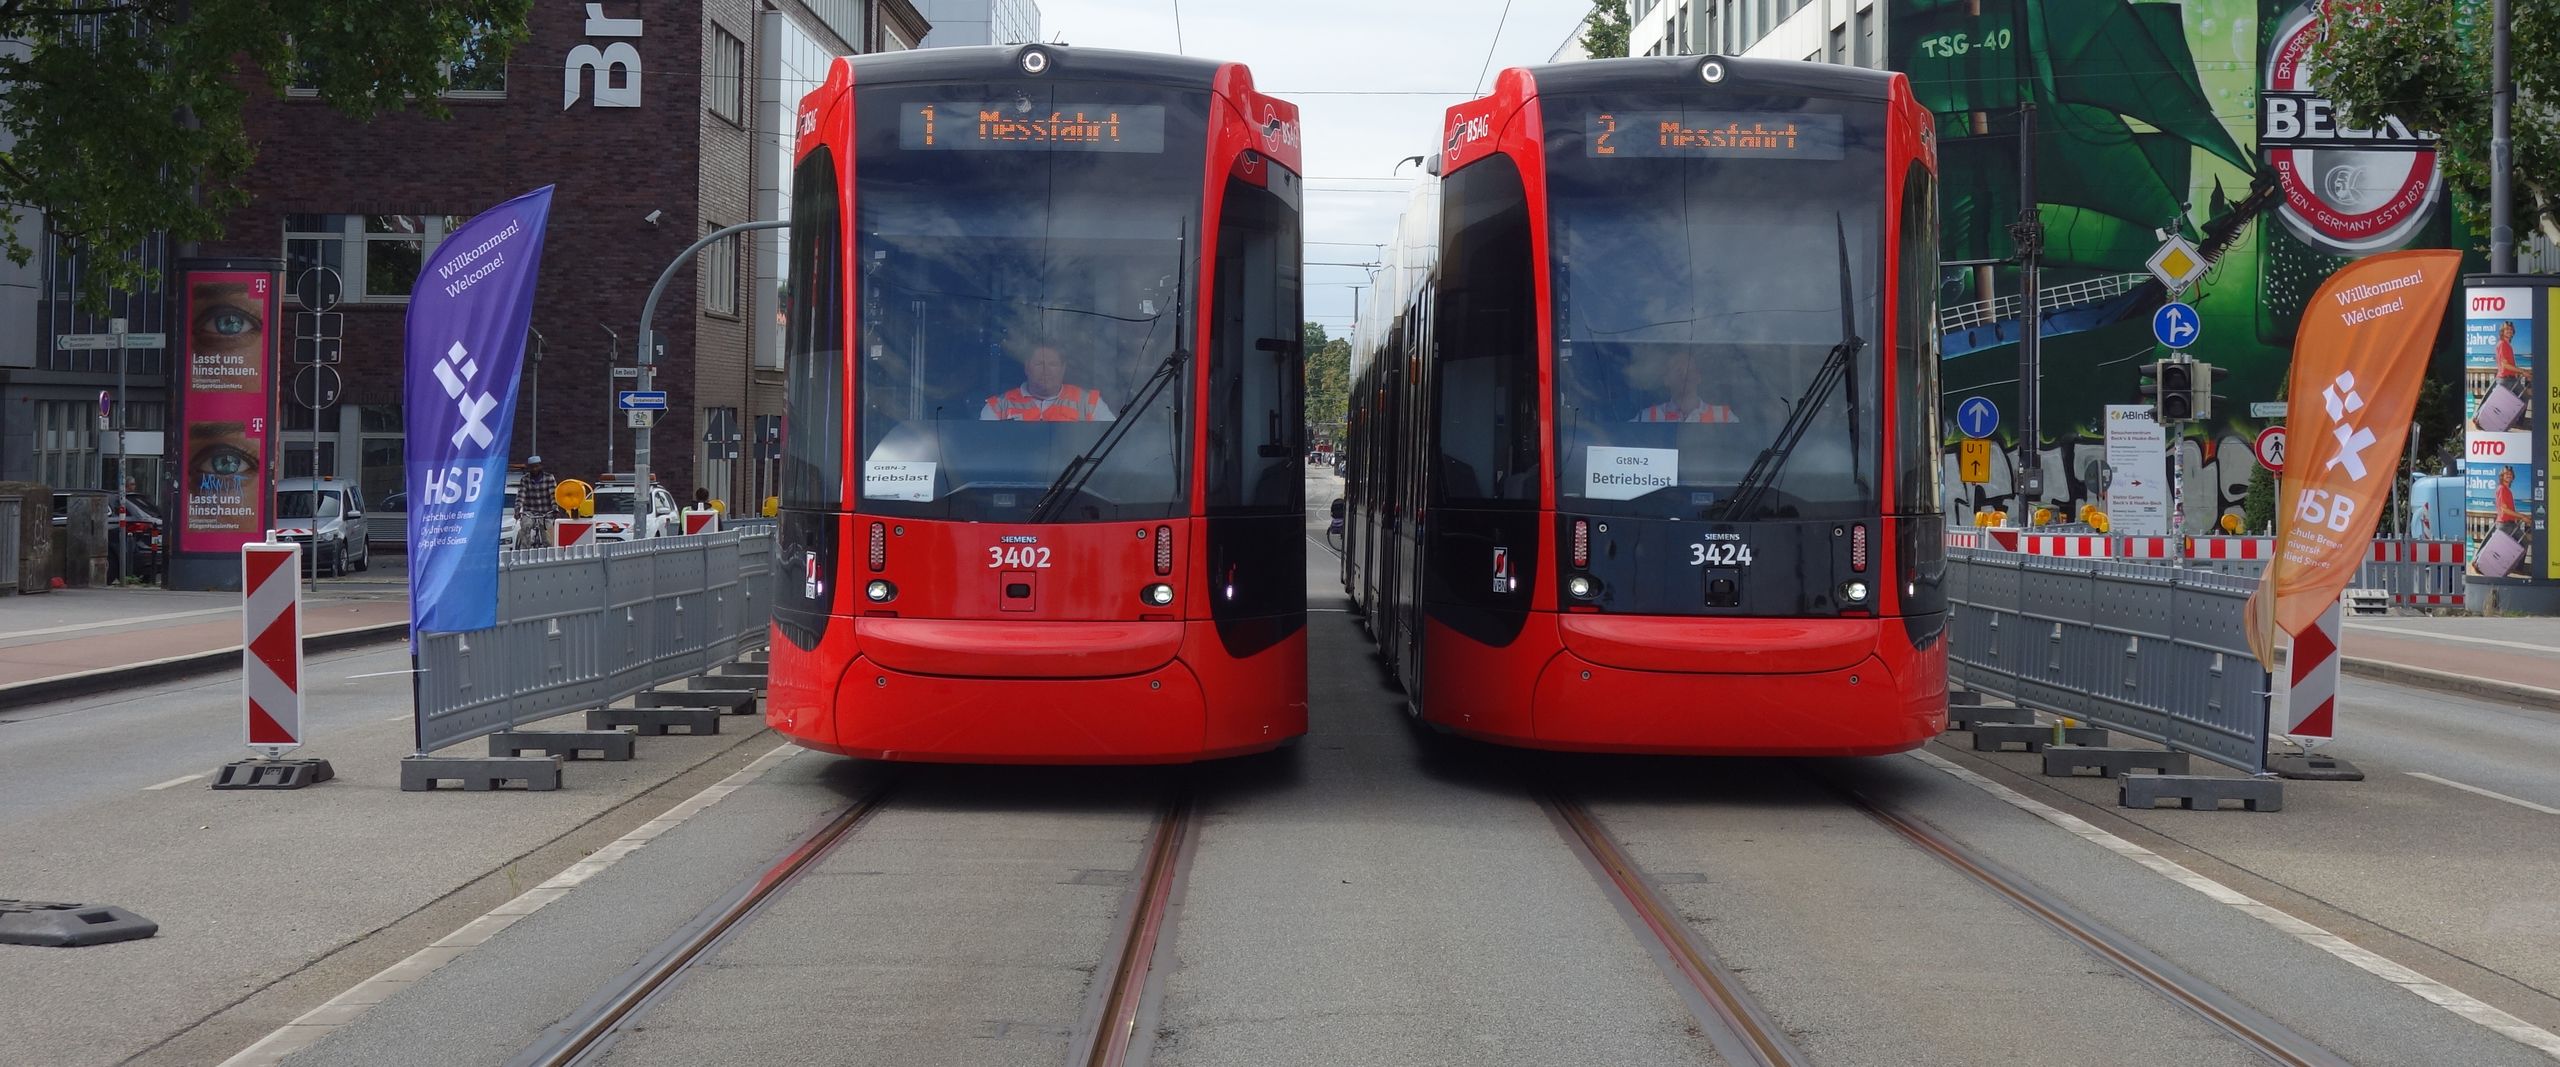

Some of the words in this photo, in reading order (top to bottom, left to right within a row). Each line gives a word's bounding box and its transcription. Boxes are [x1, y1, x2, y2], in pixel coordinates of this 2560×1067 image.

[1922, 28, 2011, 58] TSG-40
[564, 3, 643, 111] Br
[920, 104, 934, 145] 1
[979, 110, 1121, 142] Messfahrt
[1466, 113, 1490, 143] BSAG
[1597, 113, 1615, 154] 2
[1659, 121, 1798, 148] Messfahrt
[2278, 160, 2309, 209] BREMEN
[2317, 209, 2372, 232] GERMANY
[2407, 180, 2425, 205] 1873
[438, 219, 520, 280] Willkommen!
[256, 278, 266, 292] T
[445, 252, 505, 298] Welcome!
[2335, 269, 2424, 306] Willkommen!
[2341, 296, 2404, 327] Welcome!
[2472, 296, 2506, 312] OTTO
[192, 353, 220, 364] Lasst
[224, 356, 244, 364] uns
[192, 364, 258, 376] hinschauen.
[252, 418, 263, 432] T
[2122, 411, 2153, 420] ABInB
[1966, 443, 1974, 454] U
[2472, 440, 2506, 456] OTTO
[1616, 456, 1649, 466] Gt8N-2
[424, 466, 484, 506] HSB
[1592, 472, 1672, 487] Betriebslast
[188, 504, 255, 516] hinschauen.
[189, 493, 216, 504] Lasst
[220, 496, 240, 504] uns
[2293, 488, 2355, 532] HSB
[1704, 533, 1740, 541] SIEMENS
[988, 546, 1051, 569] 3402
[1690, 543, 1753, 566] 3424
